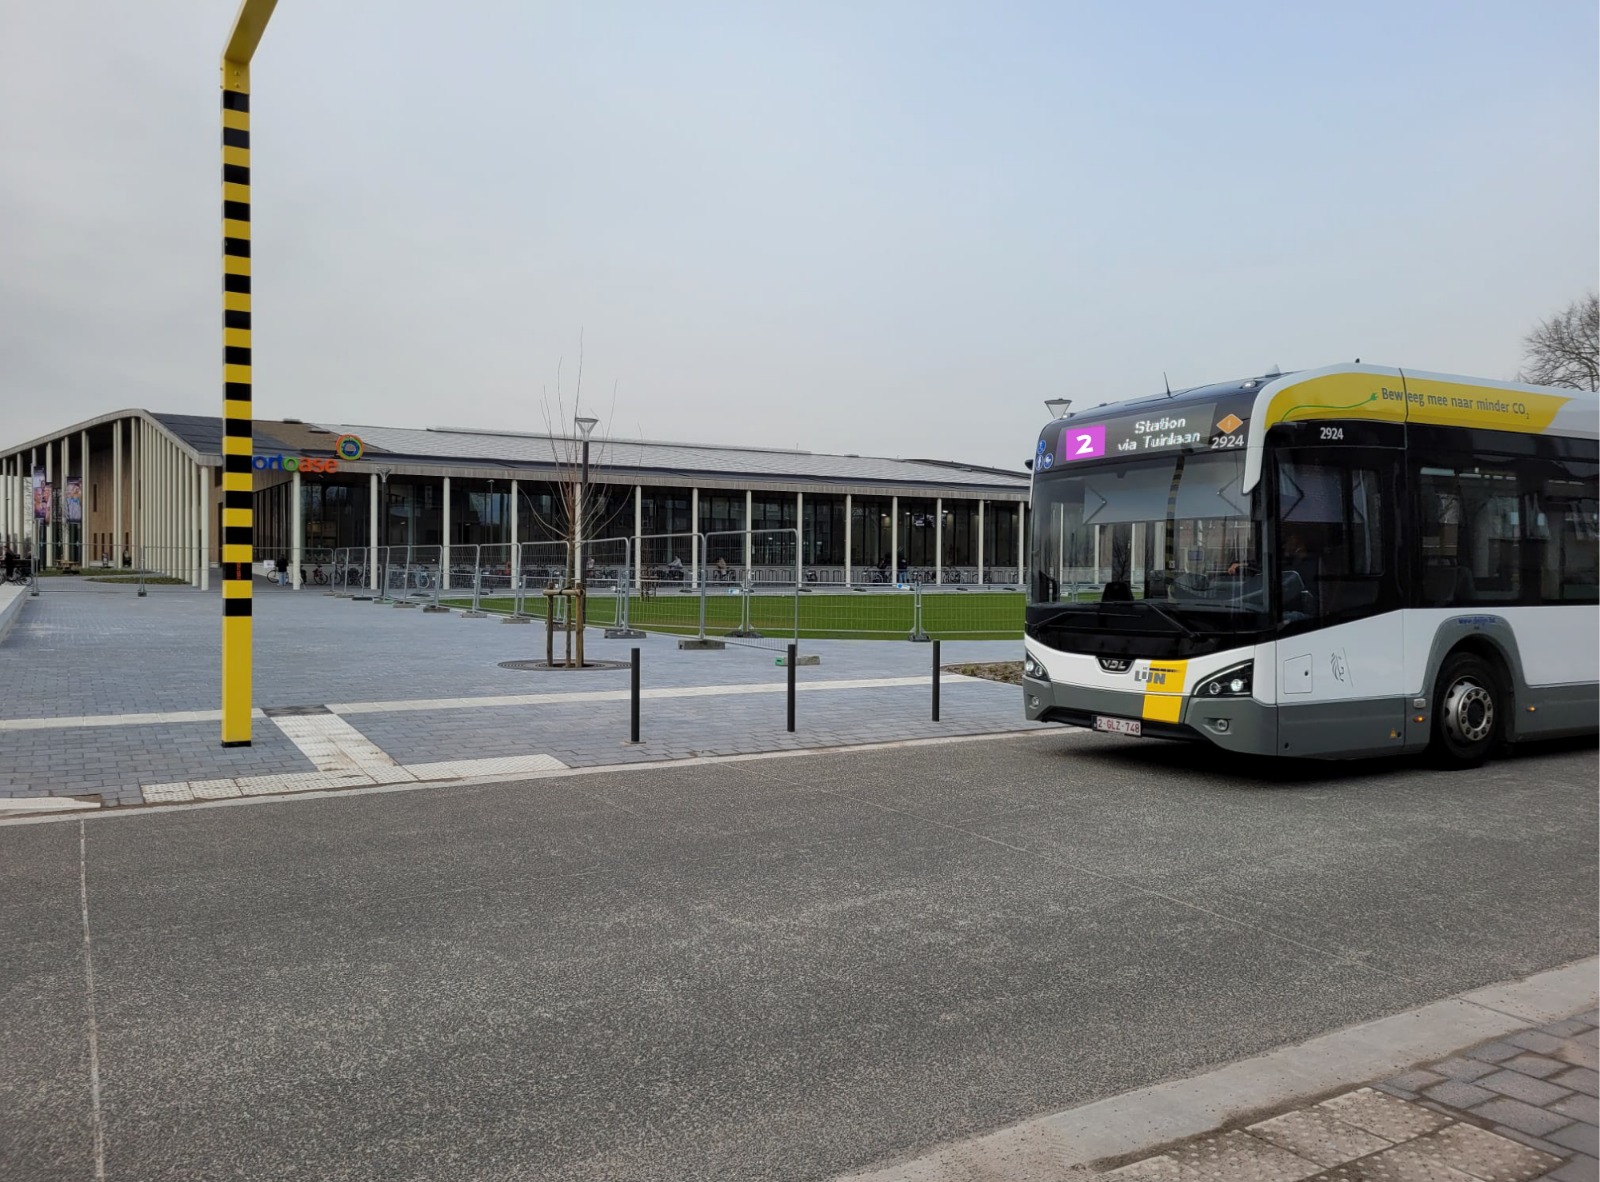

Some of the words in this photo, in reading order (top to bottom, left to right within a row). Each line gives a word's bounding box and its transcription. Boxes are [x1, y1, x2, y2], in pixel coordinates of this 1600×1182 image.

[1381, 387, 1425, 407] Beweeg
[1428, 394, 1448, 406] mee
[1451, 397, 1473, 409] naar
[1476, 398, 1510, 413] minder
[1134, 417, 1186, 434] Station
[1320, 427, 1344, 440] 2924
[1075, 434, 1094, 455] 2
[1118, 438, 1137, 451] via
[1211, 434, 1244, 449] 2924
[252, 453, 338, 474] ortoase
